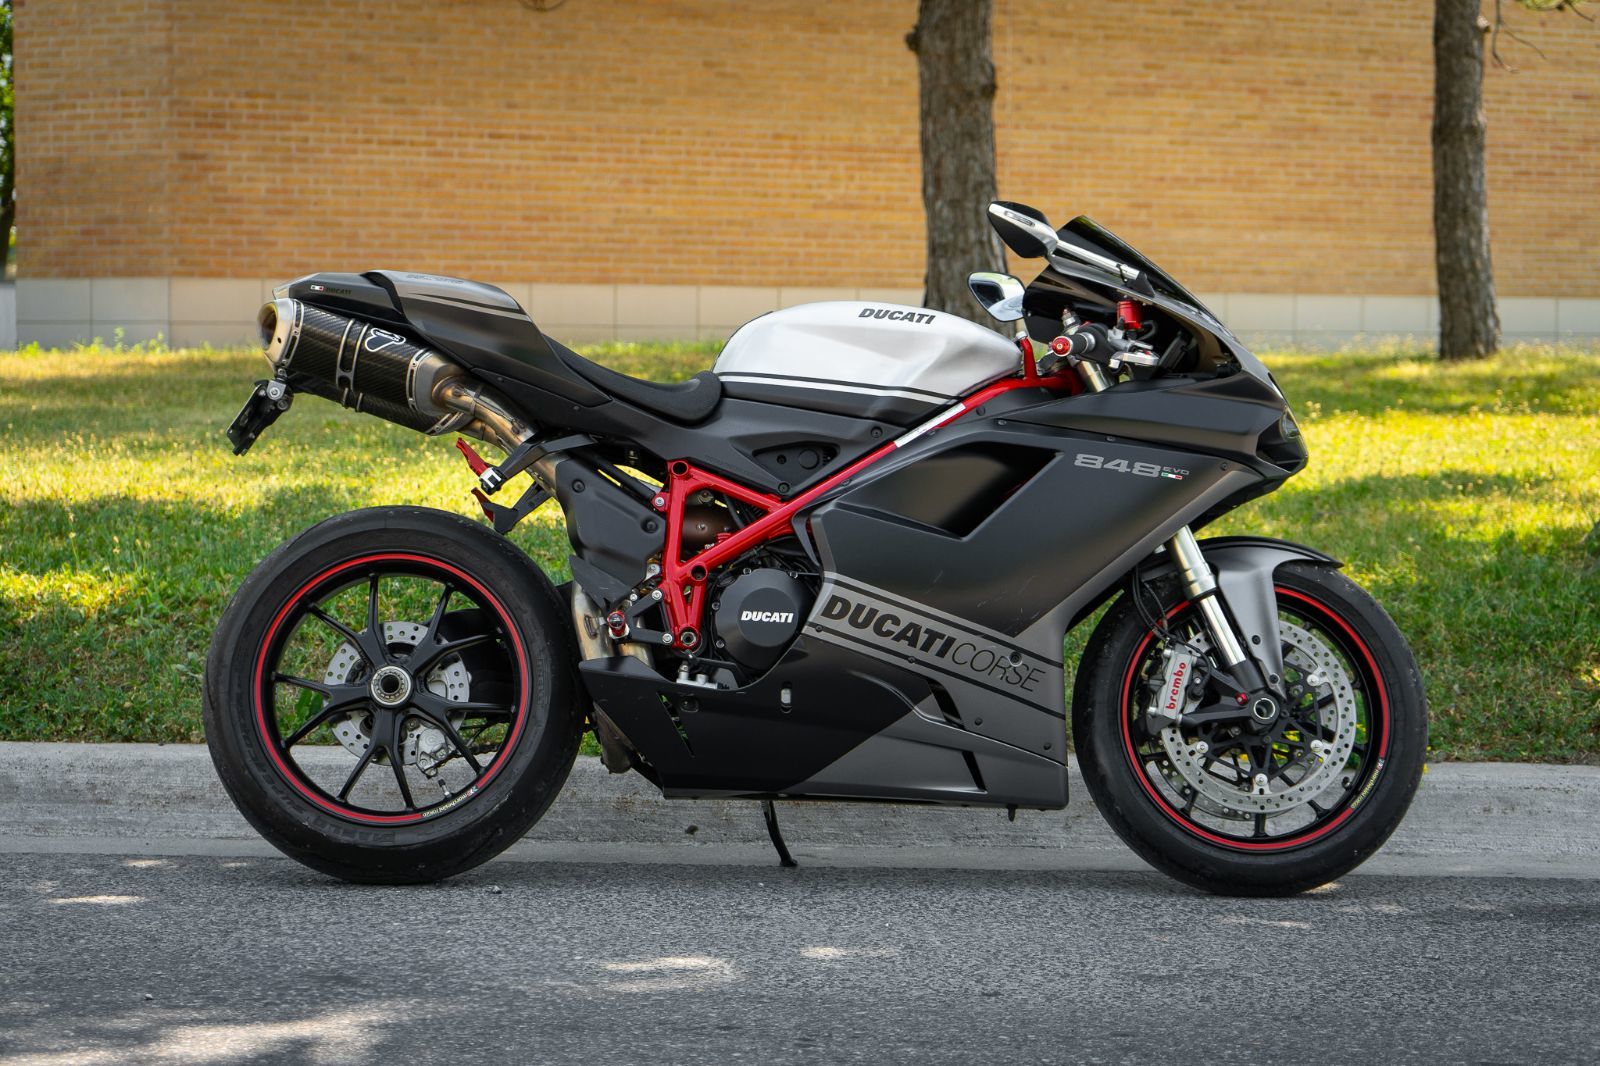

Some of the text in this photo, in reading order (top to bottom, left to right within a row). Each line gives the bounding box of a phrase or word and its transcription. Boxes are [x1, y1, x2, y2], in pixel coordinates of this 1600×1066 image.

[858, 308, 936, 324] DUCATI
[1074, 453, 1190, 477] 848 EVO
[741, 610, 794, 623] DUCATI
[820, 595, 1046, 692] DUCATI CORSE
[1165, 662, 1186, 709] brembo
